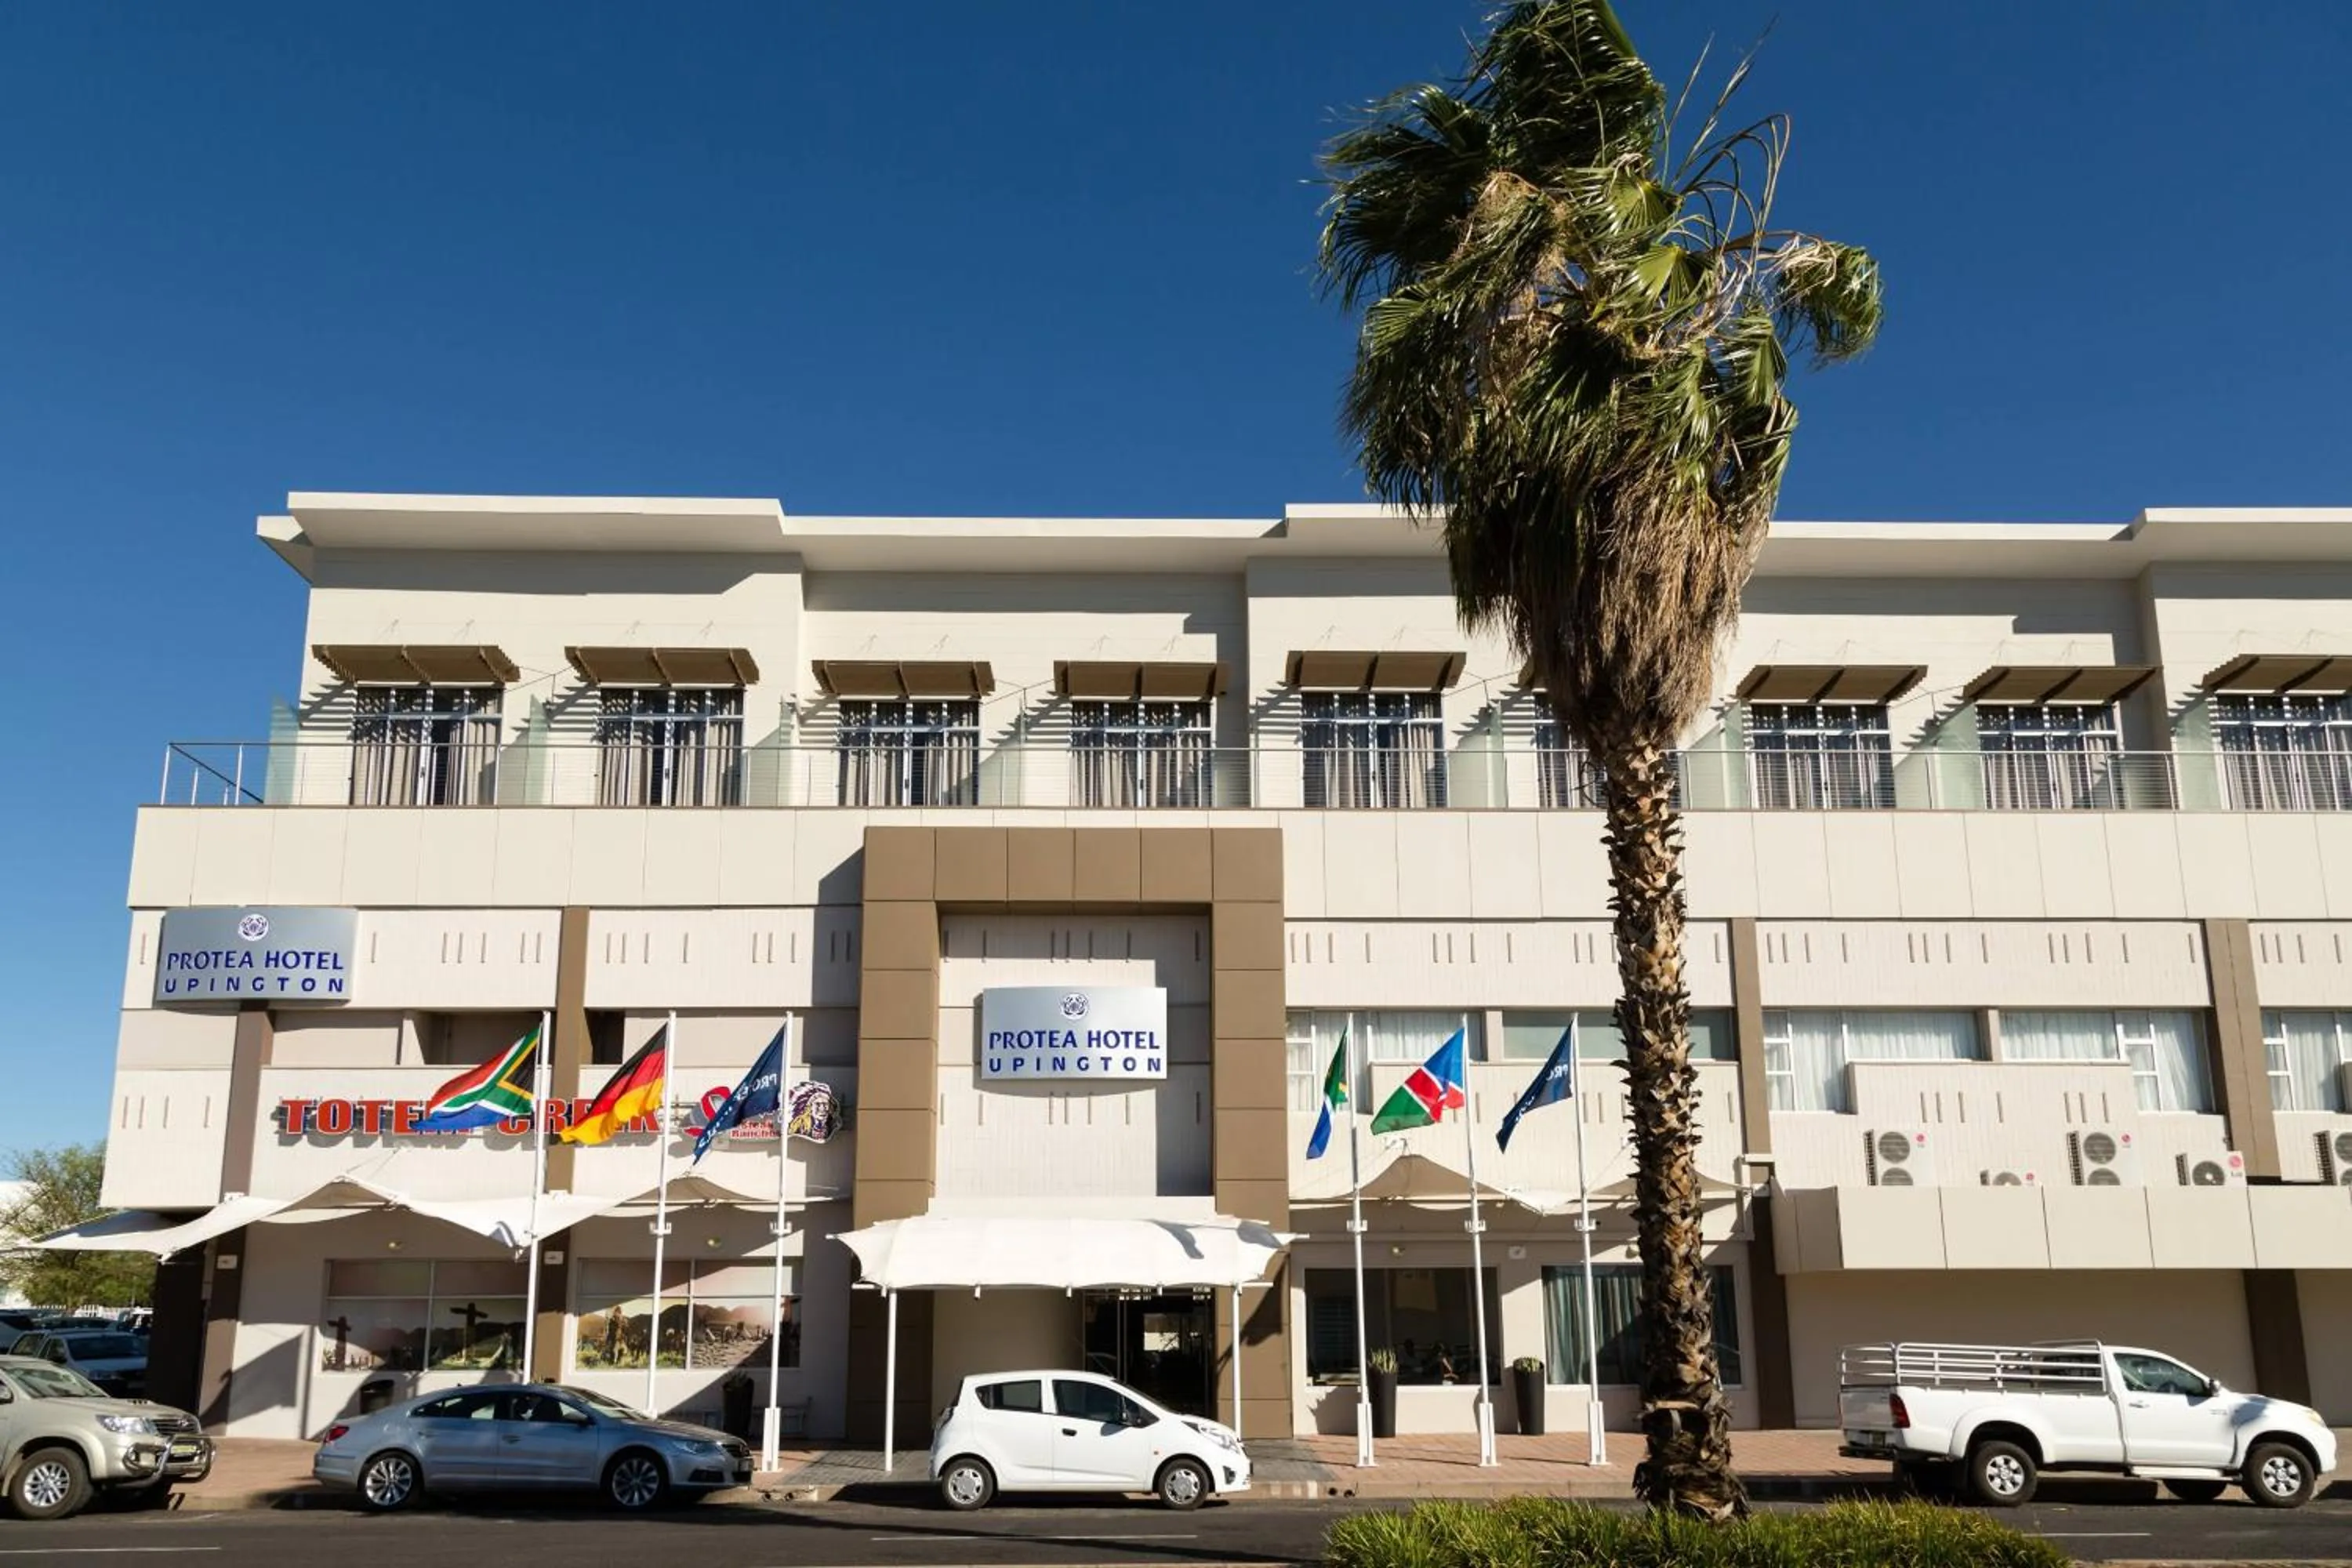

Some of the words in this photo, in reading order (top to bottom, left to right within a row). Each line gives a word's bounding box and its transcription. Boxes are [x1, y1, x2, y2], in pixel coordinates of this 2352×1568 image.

[166, 949, 254, 971] PROTEA
[264, 950, 343, 971] HOTEL
[164, 976, 344, 993] UPINGTON
[988, 1029, 1077, 1050] PROTEA
[1087, 1030, 1160, 1050] HOTEL
[988, 1055, 1162, 1073] UPINGTON
[281, 1099, 471, 1135] TOTE
